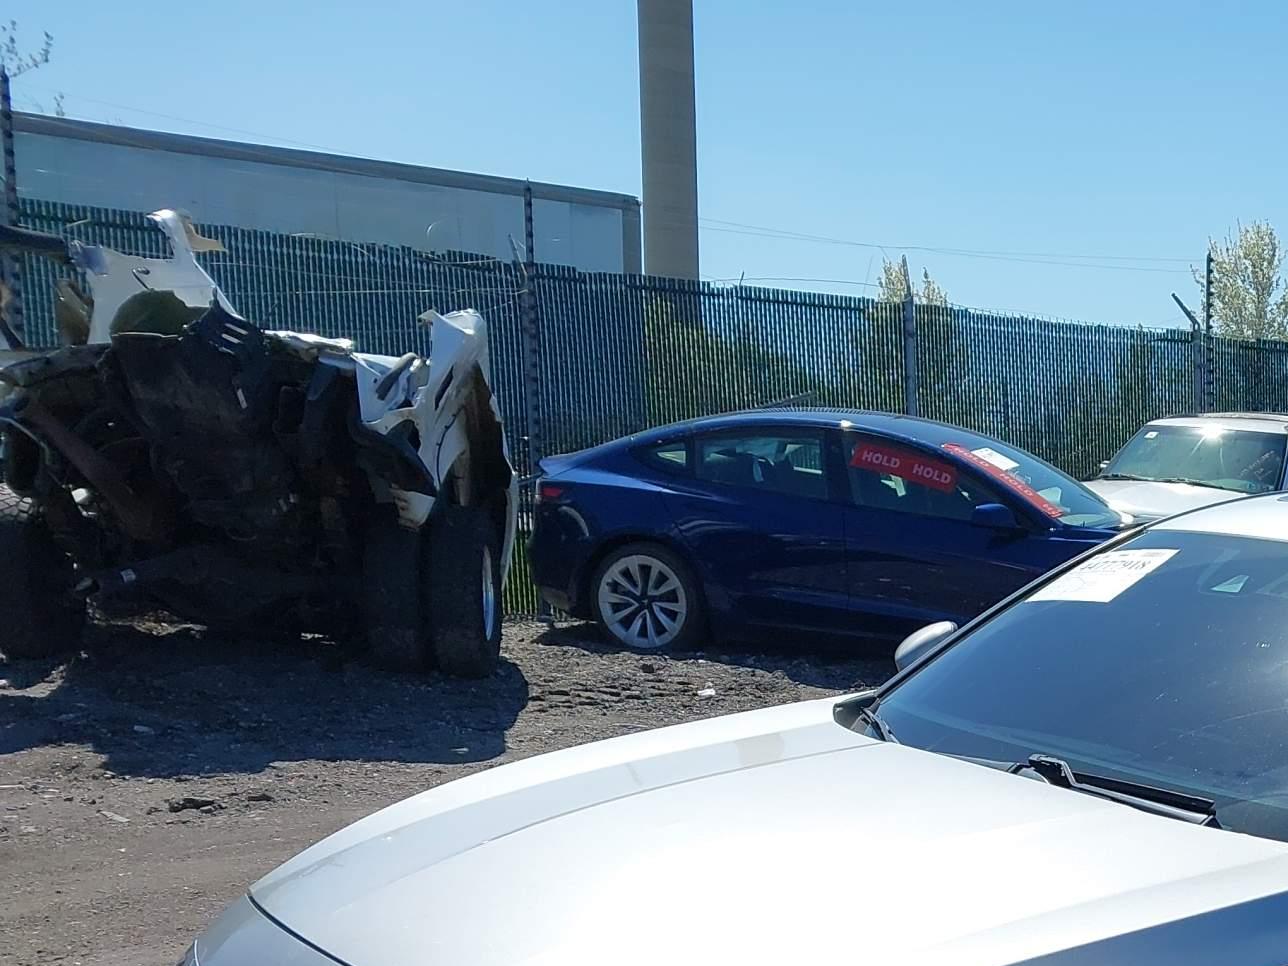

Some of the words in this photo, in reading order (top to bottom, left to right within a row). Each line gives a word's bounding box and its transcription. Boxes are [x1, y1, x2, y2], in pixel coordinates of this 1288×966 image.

[861, 450, 901, 469] HOLD
[912, 463, 952, 484] HOLD
[999, 472, 1034, 497] HOLD
